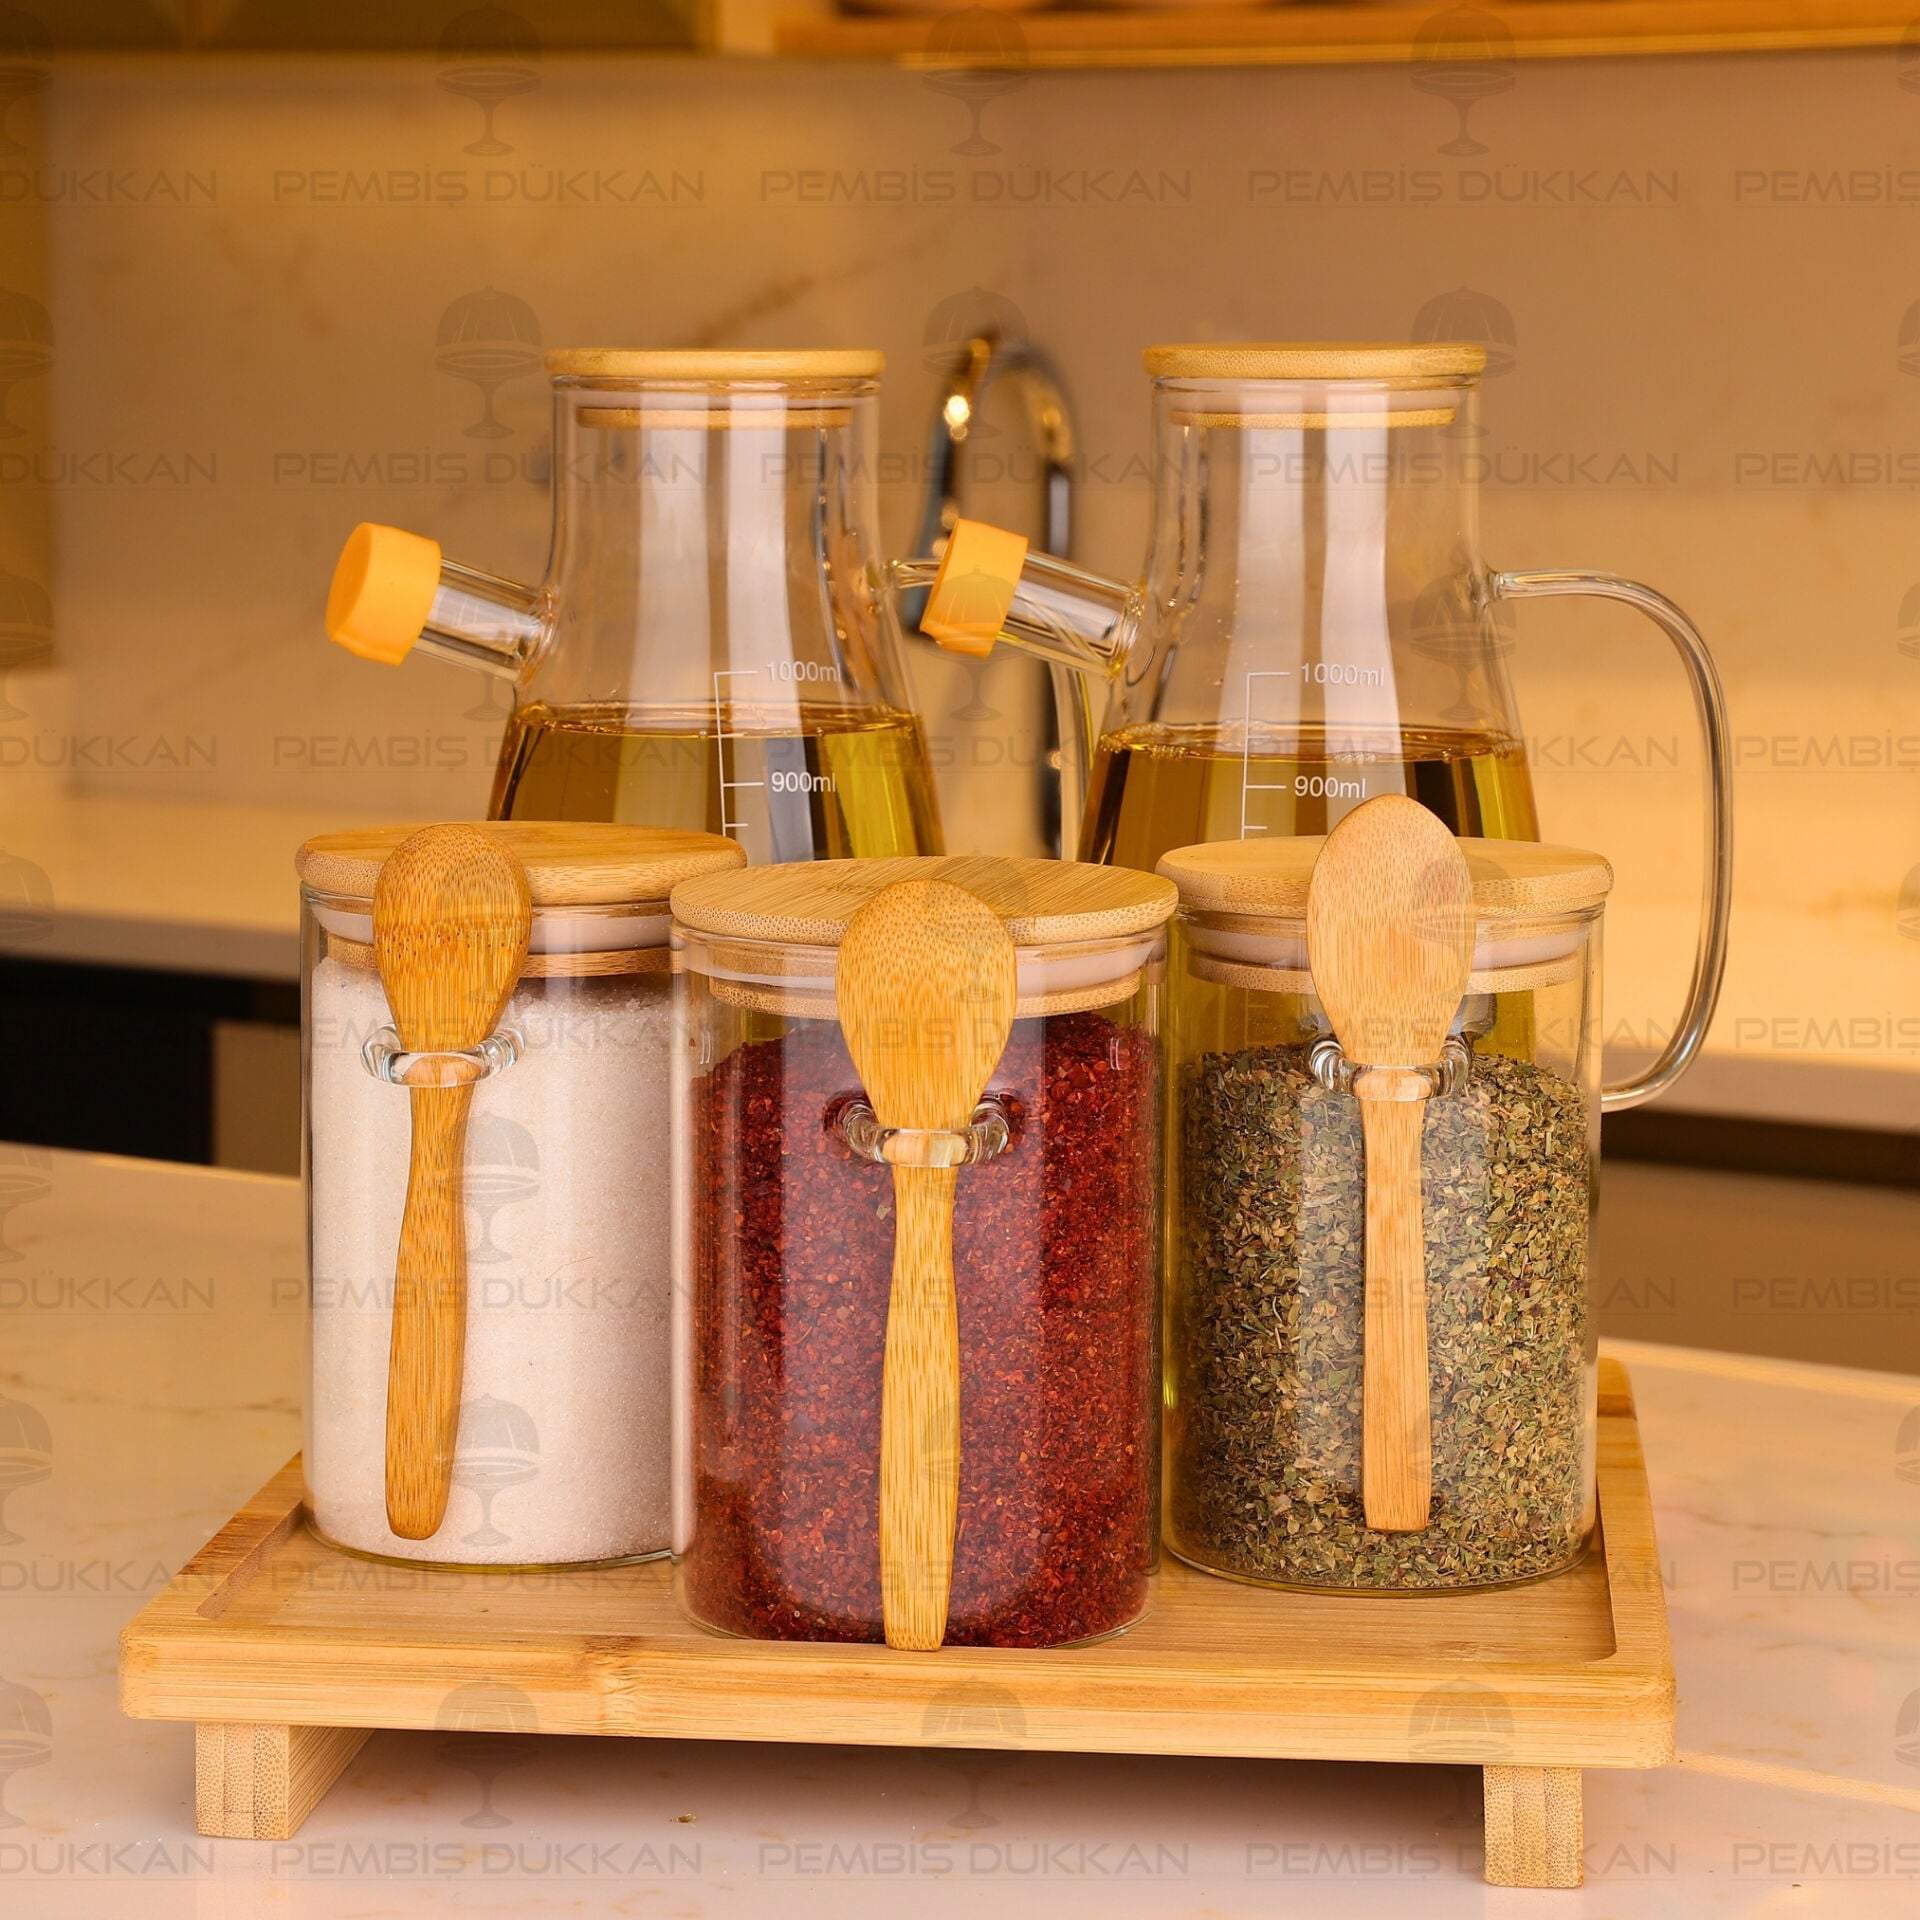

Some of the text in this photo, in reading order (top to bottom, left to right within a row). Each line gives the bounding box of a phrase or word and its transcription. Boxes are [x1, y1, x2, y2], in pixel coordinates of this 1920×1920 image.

[767, 660, 842, 682] 1000ml
[1300, 662, 1385, 687] 1000ml
[771, 771, 836, 793] 900ml
[1294, 775, 1366, 799] 900ml
